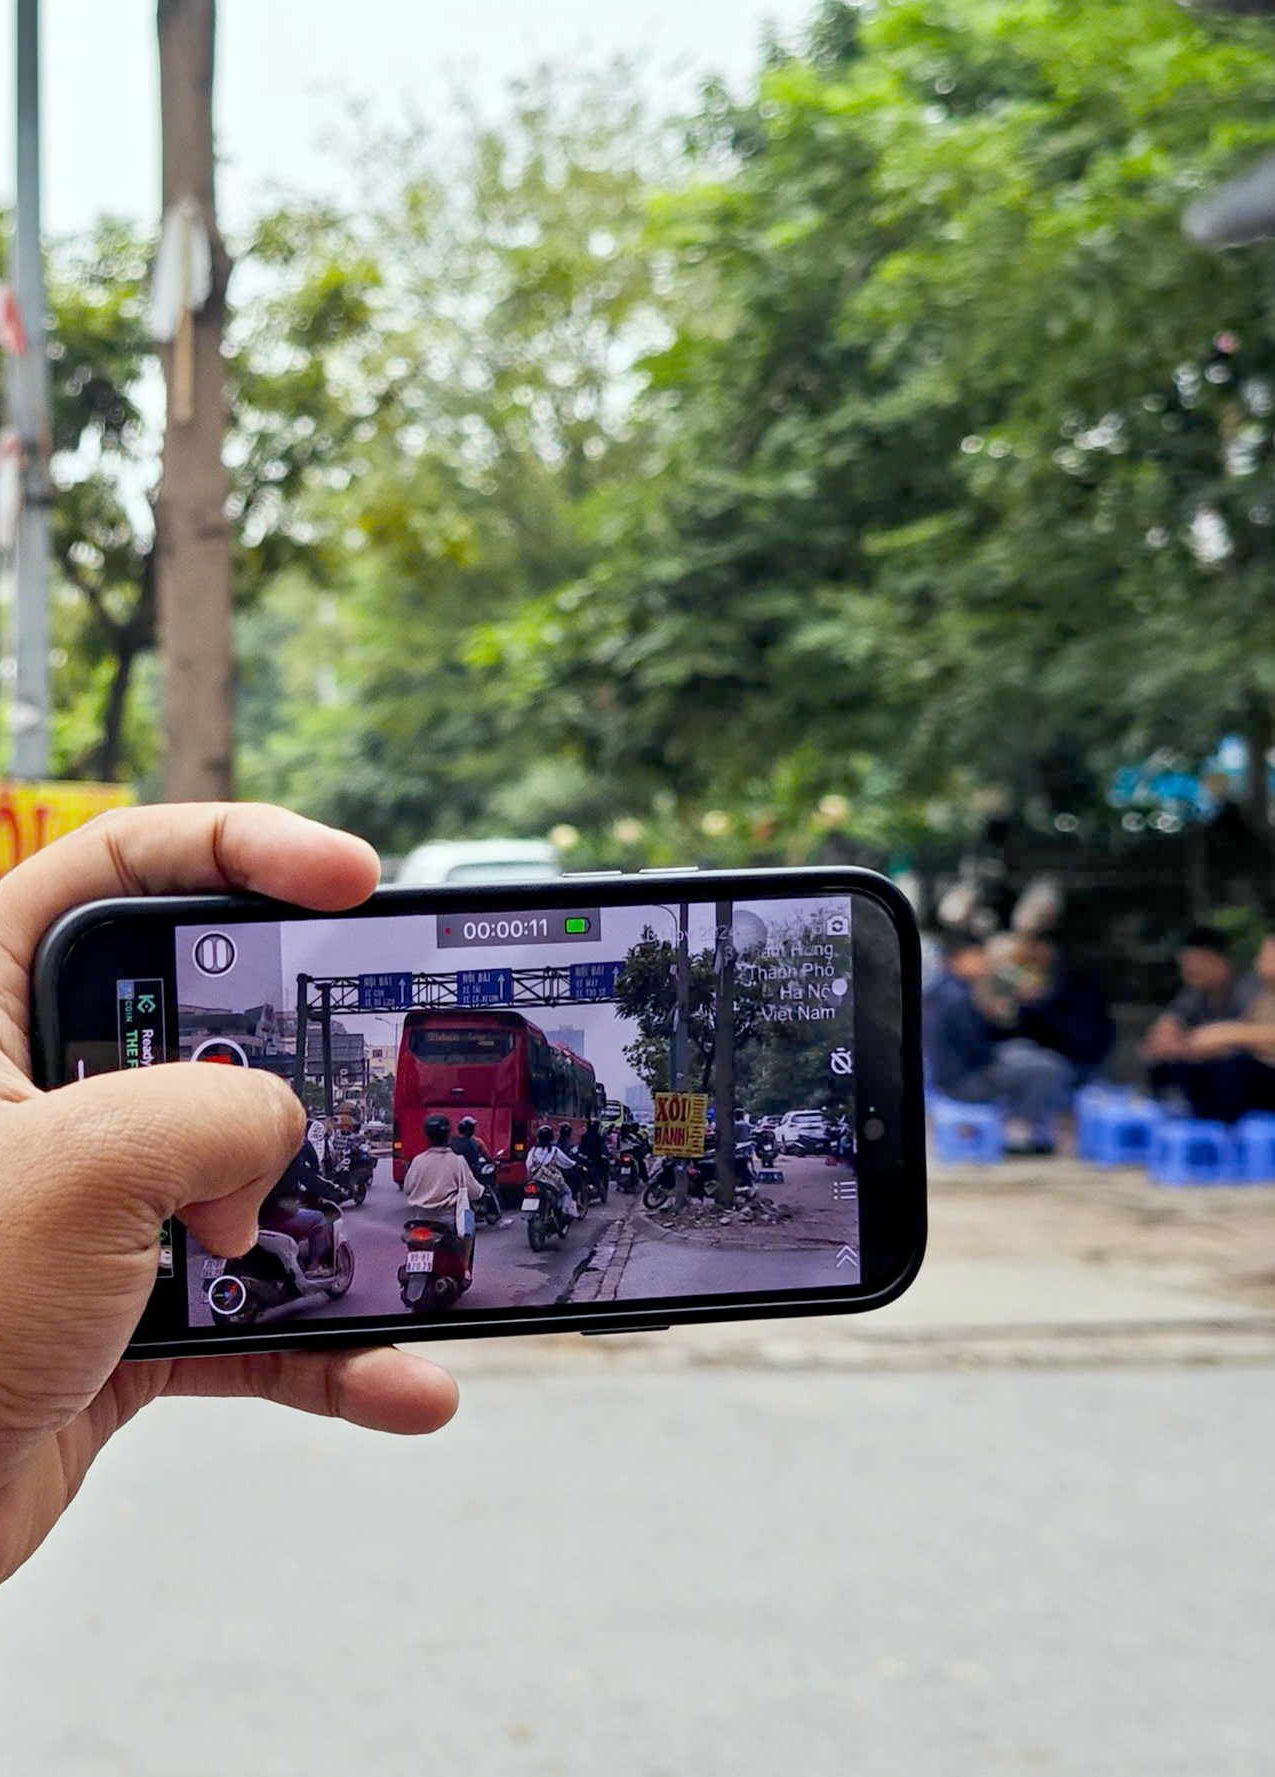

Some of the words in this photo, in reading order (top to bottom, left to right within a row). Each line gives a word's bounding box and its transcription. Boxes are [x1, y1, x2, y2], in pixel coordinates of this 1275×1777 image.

[463, 919, 548, 940] 00:00:11
[798, 1005, 836, 1021] Nam
[126, 1030, 139, 1057] THE
